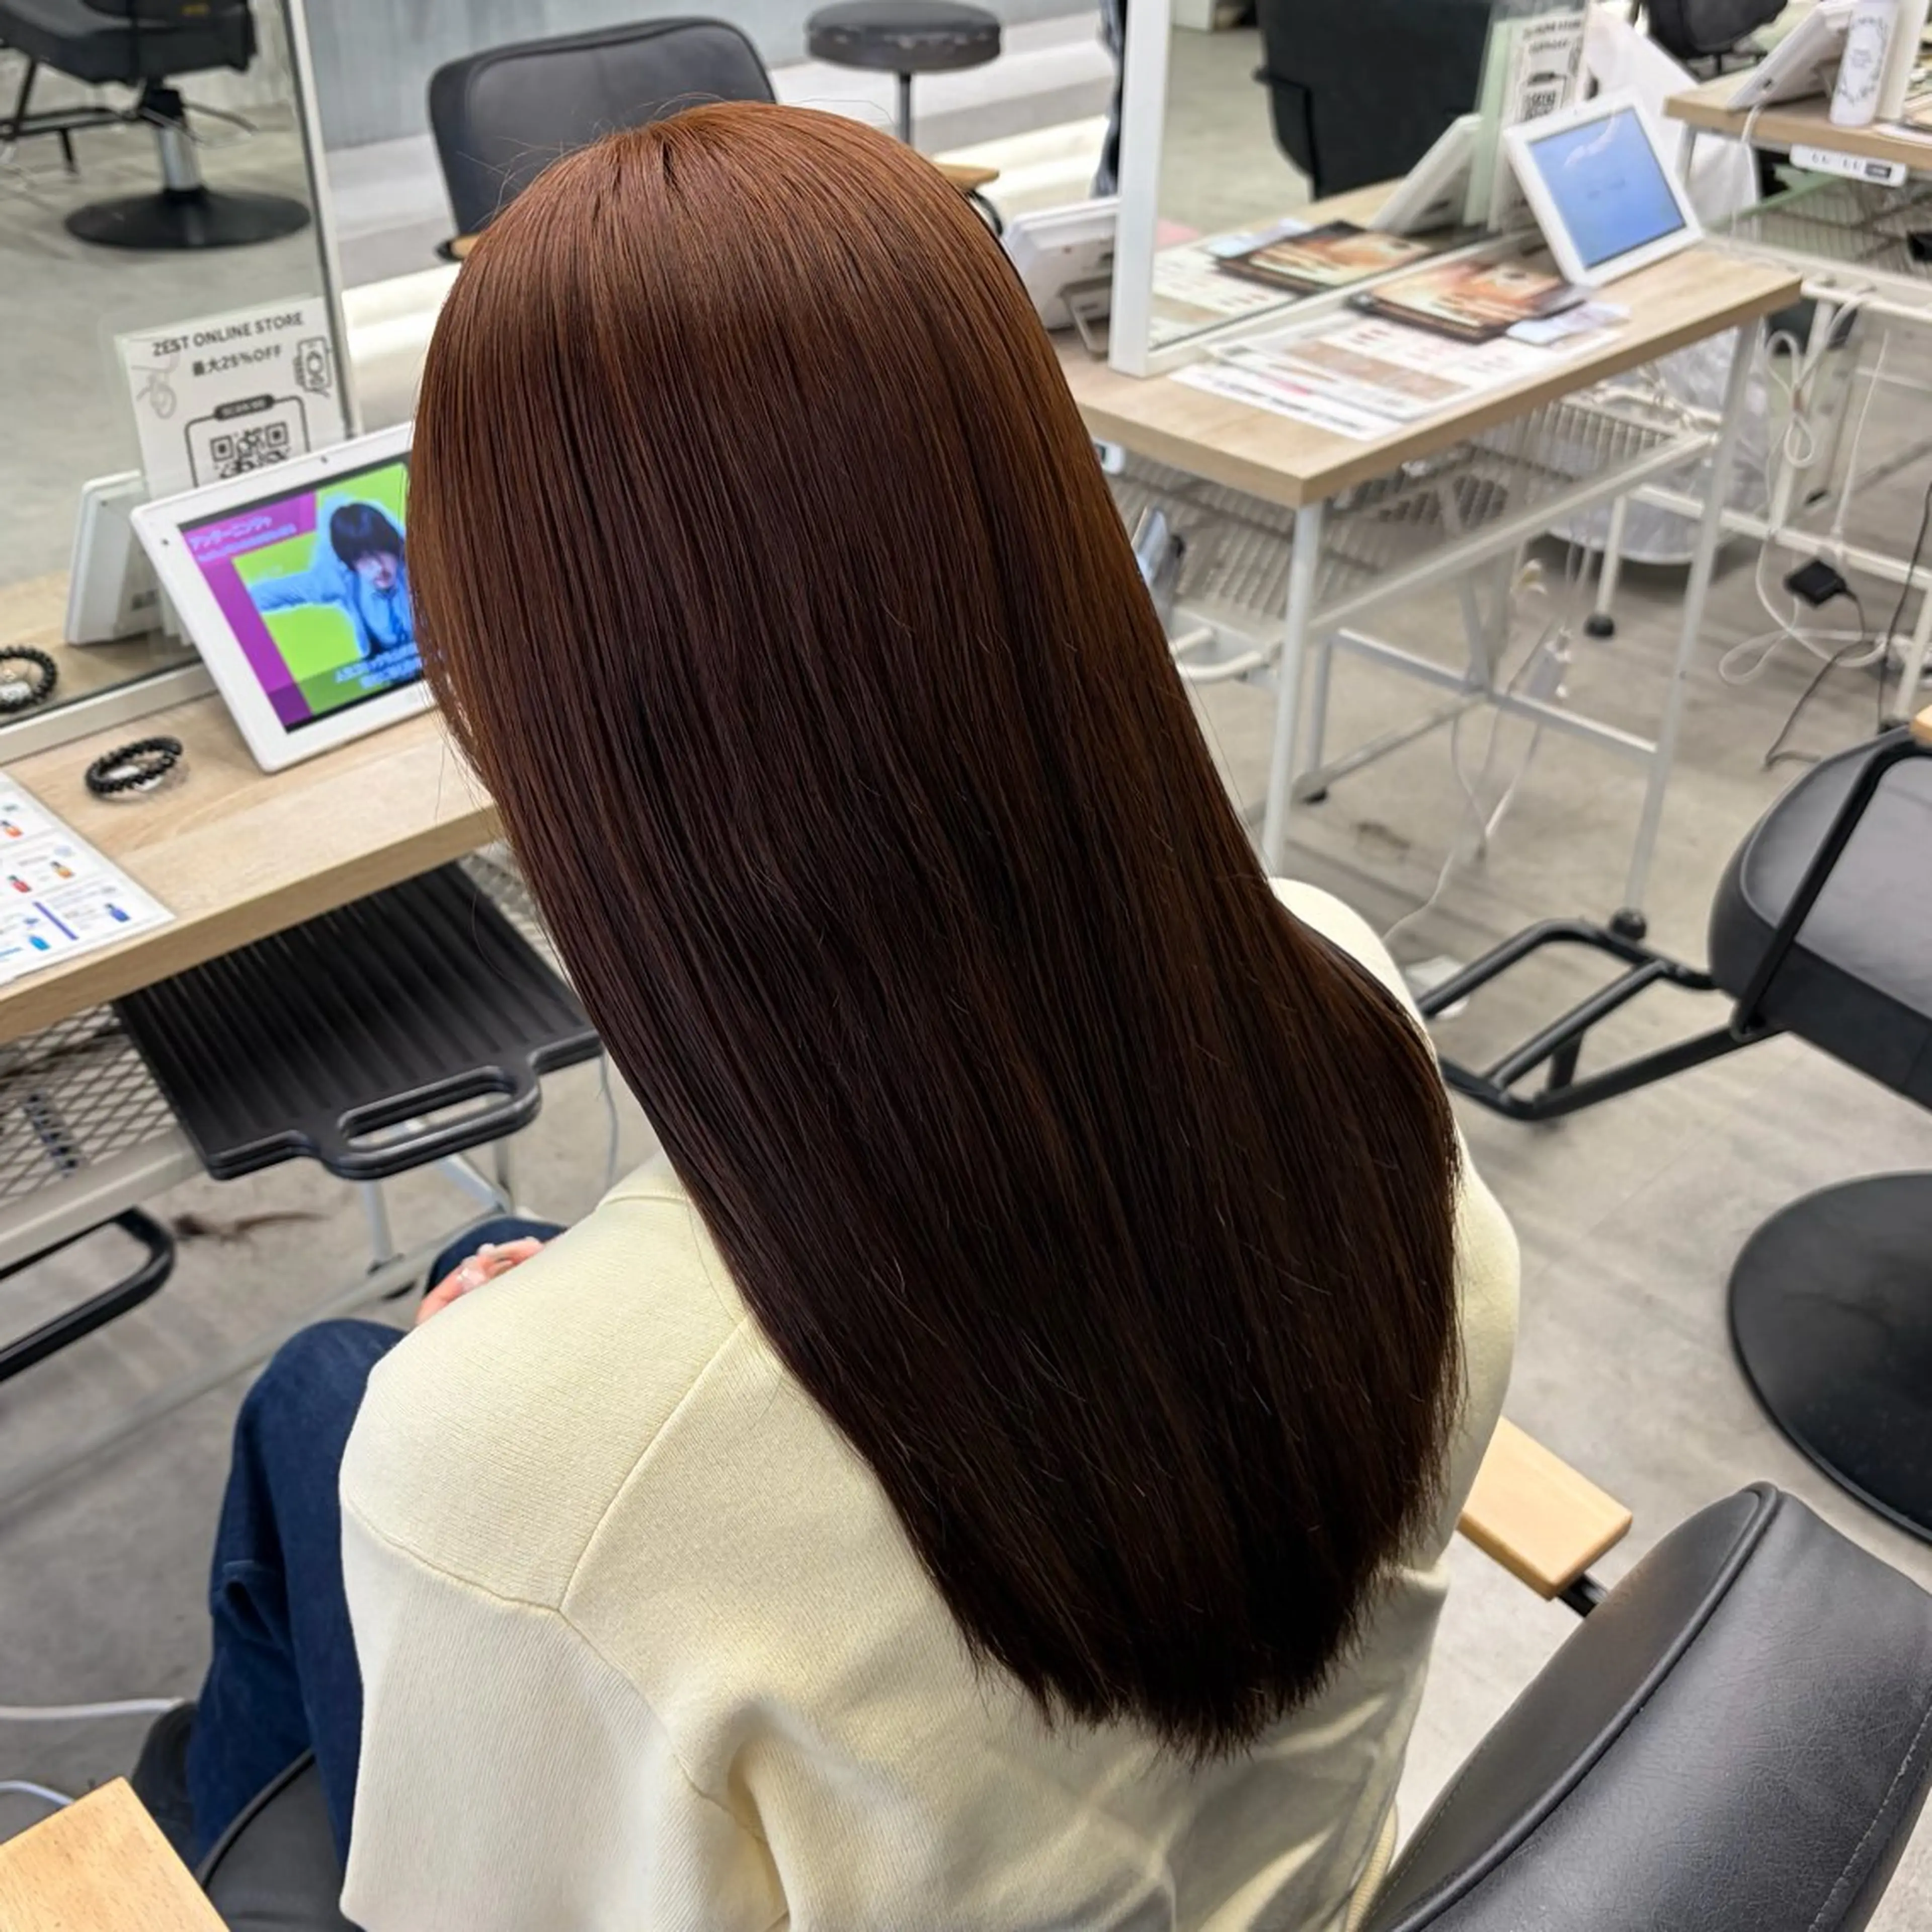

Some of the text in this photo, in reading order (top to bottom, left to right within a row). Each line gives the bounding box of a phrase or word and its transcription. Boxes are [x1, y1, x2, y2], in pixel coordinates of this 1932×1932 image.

[153, 311, 303, 357] ZEST ONLINE STORE
